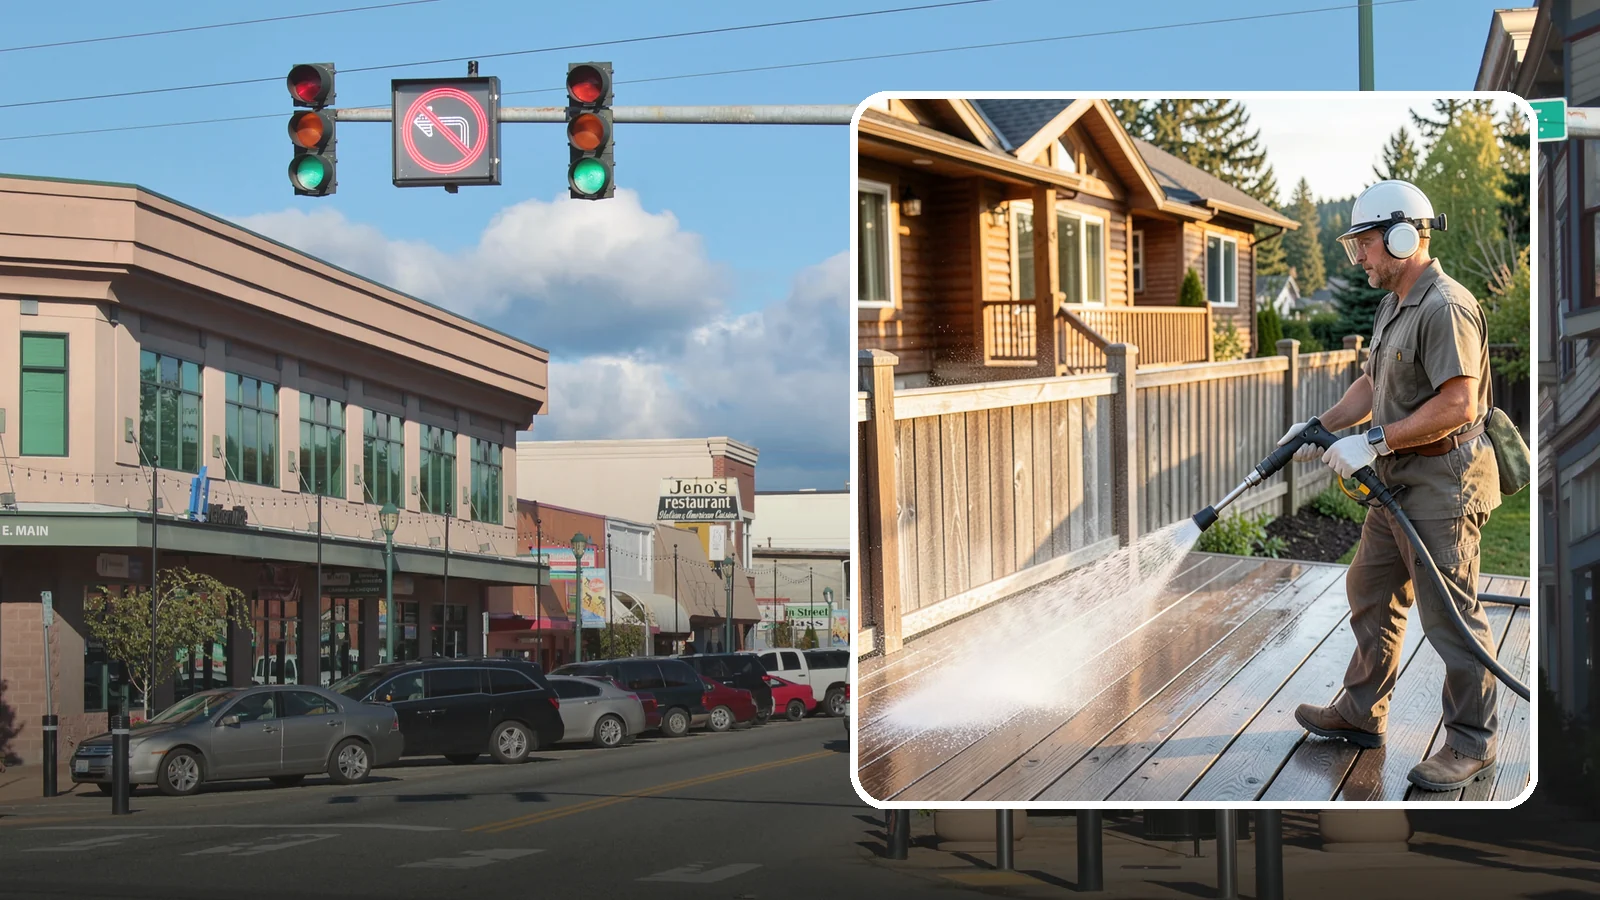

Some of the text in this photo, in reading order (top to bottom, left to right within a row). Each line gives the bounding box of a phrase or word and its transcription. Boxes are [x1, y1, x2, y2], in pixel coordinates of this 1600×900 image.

[670, 480, 727, 494] Jeno's
[665, 497, 730, 509] restaurant
[659, 510, 681, 519] Italian
[686, 509, 715, 519] American
[715, 509, 737, 519] Cuisine
[2, 525, 49, 536] E. MAIN
[797, 607, 829, 616] Street
